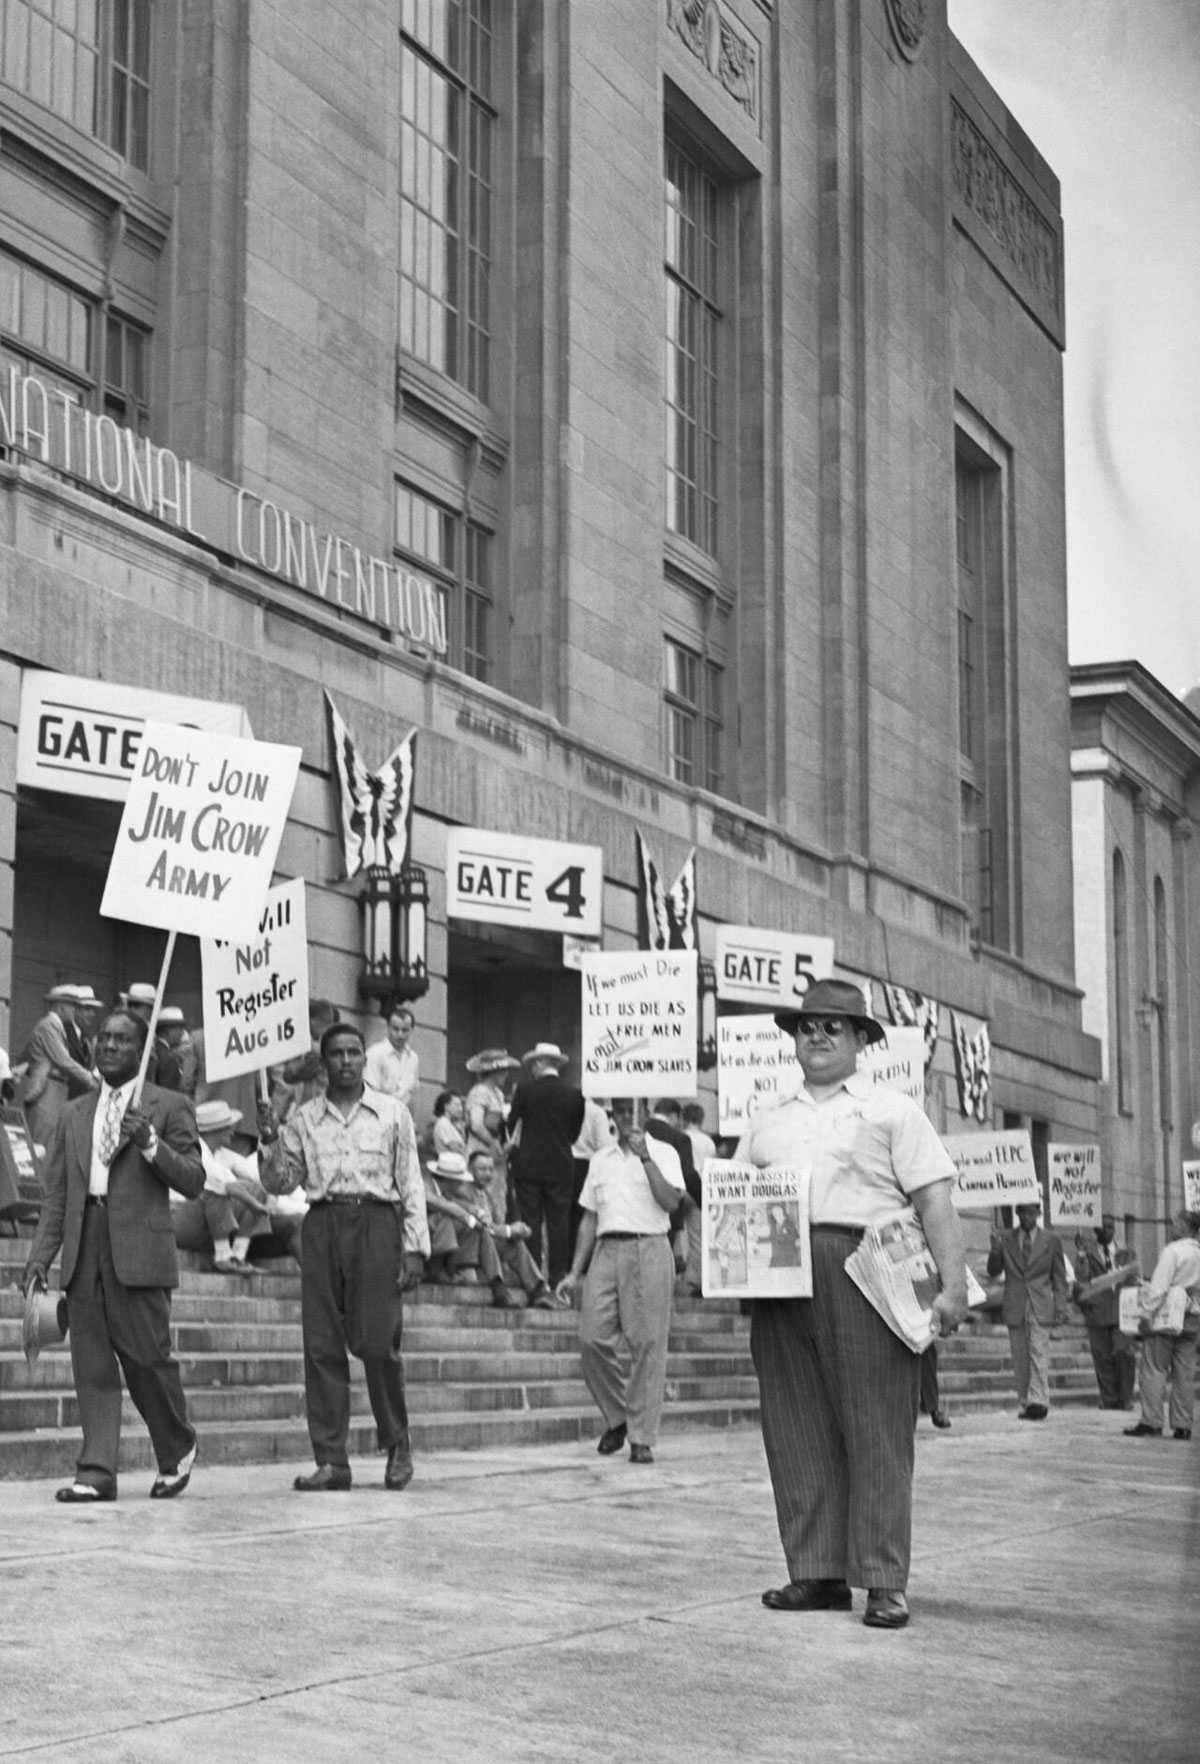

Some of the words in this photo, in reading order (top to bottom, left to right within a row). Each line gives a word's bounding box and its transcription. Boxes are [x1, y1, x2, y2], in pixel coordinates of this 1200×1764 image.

[237, 487, 447, 655] CONVENTION
[37, 714, 143, 770] GATE
[141, 746, 199, 788] DON'T
[207, 758, 269, 802] JOIN
[145, 849, 232, 901] ARMY
[456, 861, 533, 902] GATE
[545, 865, 587, 919] 4
[234, 937, 272, 976] Not
[723, 952, 781, 986] GATE
[792, 953, 817, 996] 5
[215, 972, 298, 1023] Register
[586, 972, 599, 999] If
[601, 977, 617, 991] we
[620, 962, 649, 986] must
[656, 958, 681, 978] Die
[588, 1001, 610, 1017] LET
[618, 1001, 635, 1017] US
[640, 1001, 661, 1017] DIE
[667, 1001, 687, 1017] AS
[276, 1018, 296, 1043] 16
[616, 1023, 645, 1038] FREE
[651, 1023, 683, 1038] MEN
[585, 1059, 600, 1074] AS
[603, 1059, 623, 1074] JIM
[657, 1059, 693, 1074] SLAVES
[753, 1077, 778, 1093] NOT
[717, 1184, 747, 1199] WANT
